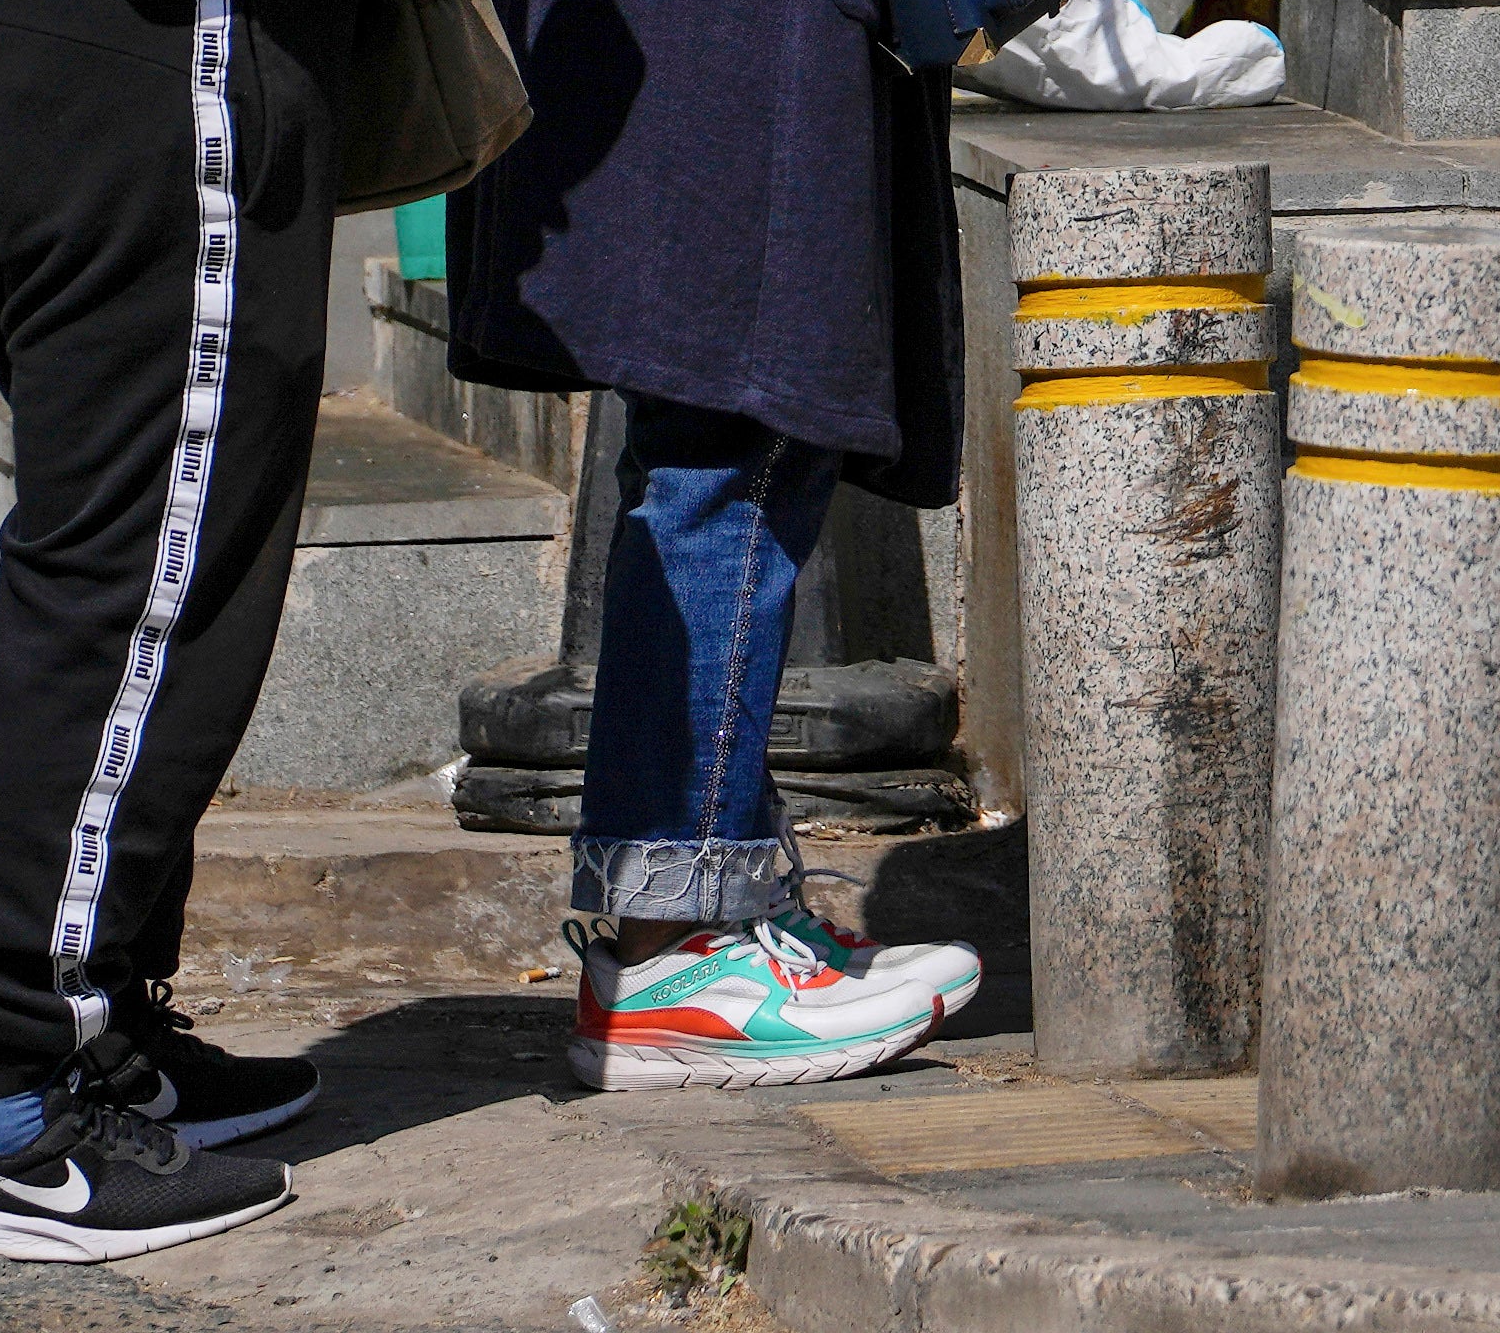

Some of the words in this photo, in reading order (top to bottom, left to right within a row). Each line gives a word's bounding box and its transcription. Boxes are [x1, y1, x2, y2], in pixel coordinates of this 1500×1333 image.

[200, 32, 219, 87] PUMA
[203, 136, 222, 186] PUMA
[204, 233, 226, 285] PUMA
[196, 332, 219, 383] PUMA
[180, 428, 206, 482] PUMA
[163, 528, 188, 585] PUMA
[135, 625, 161, 680] PUMA
[103, 724, 130, 779] PUMA
[78, 822, 100, 875] PUMA
[650, 960, 721, 1004] KOOLARA
